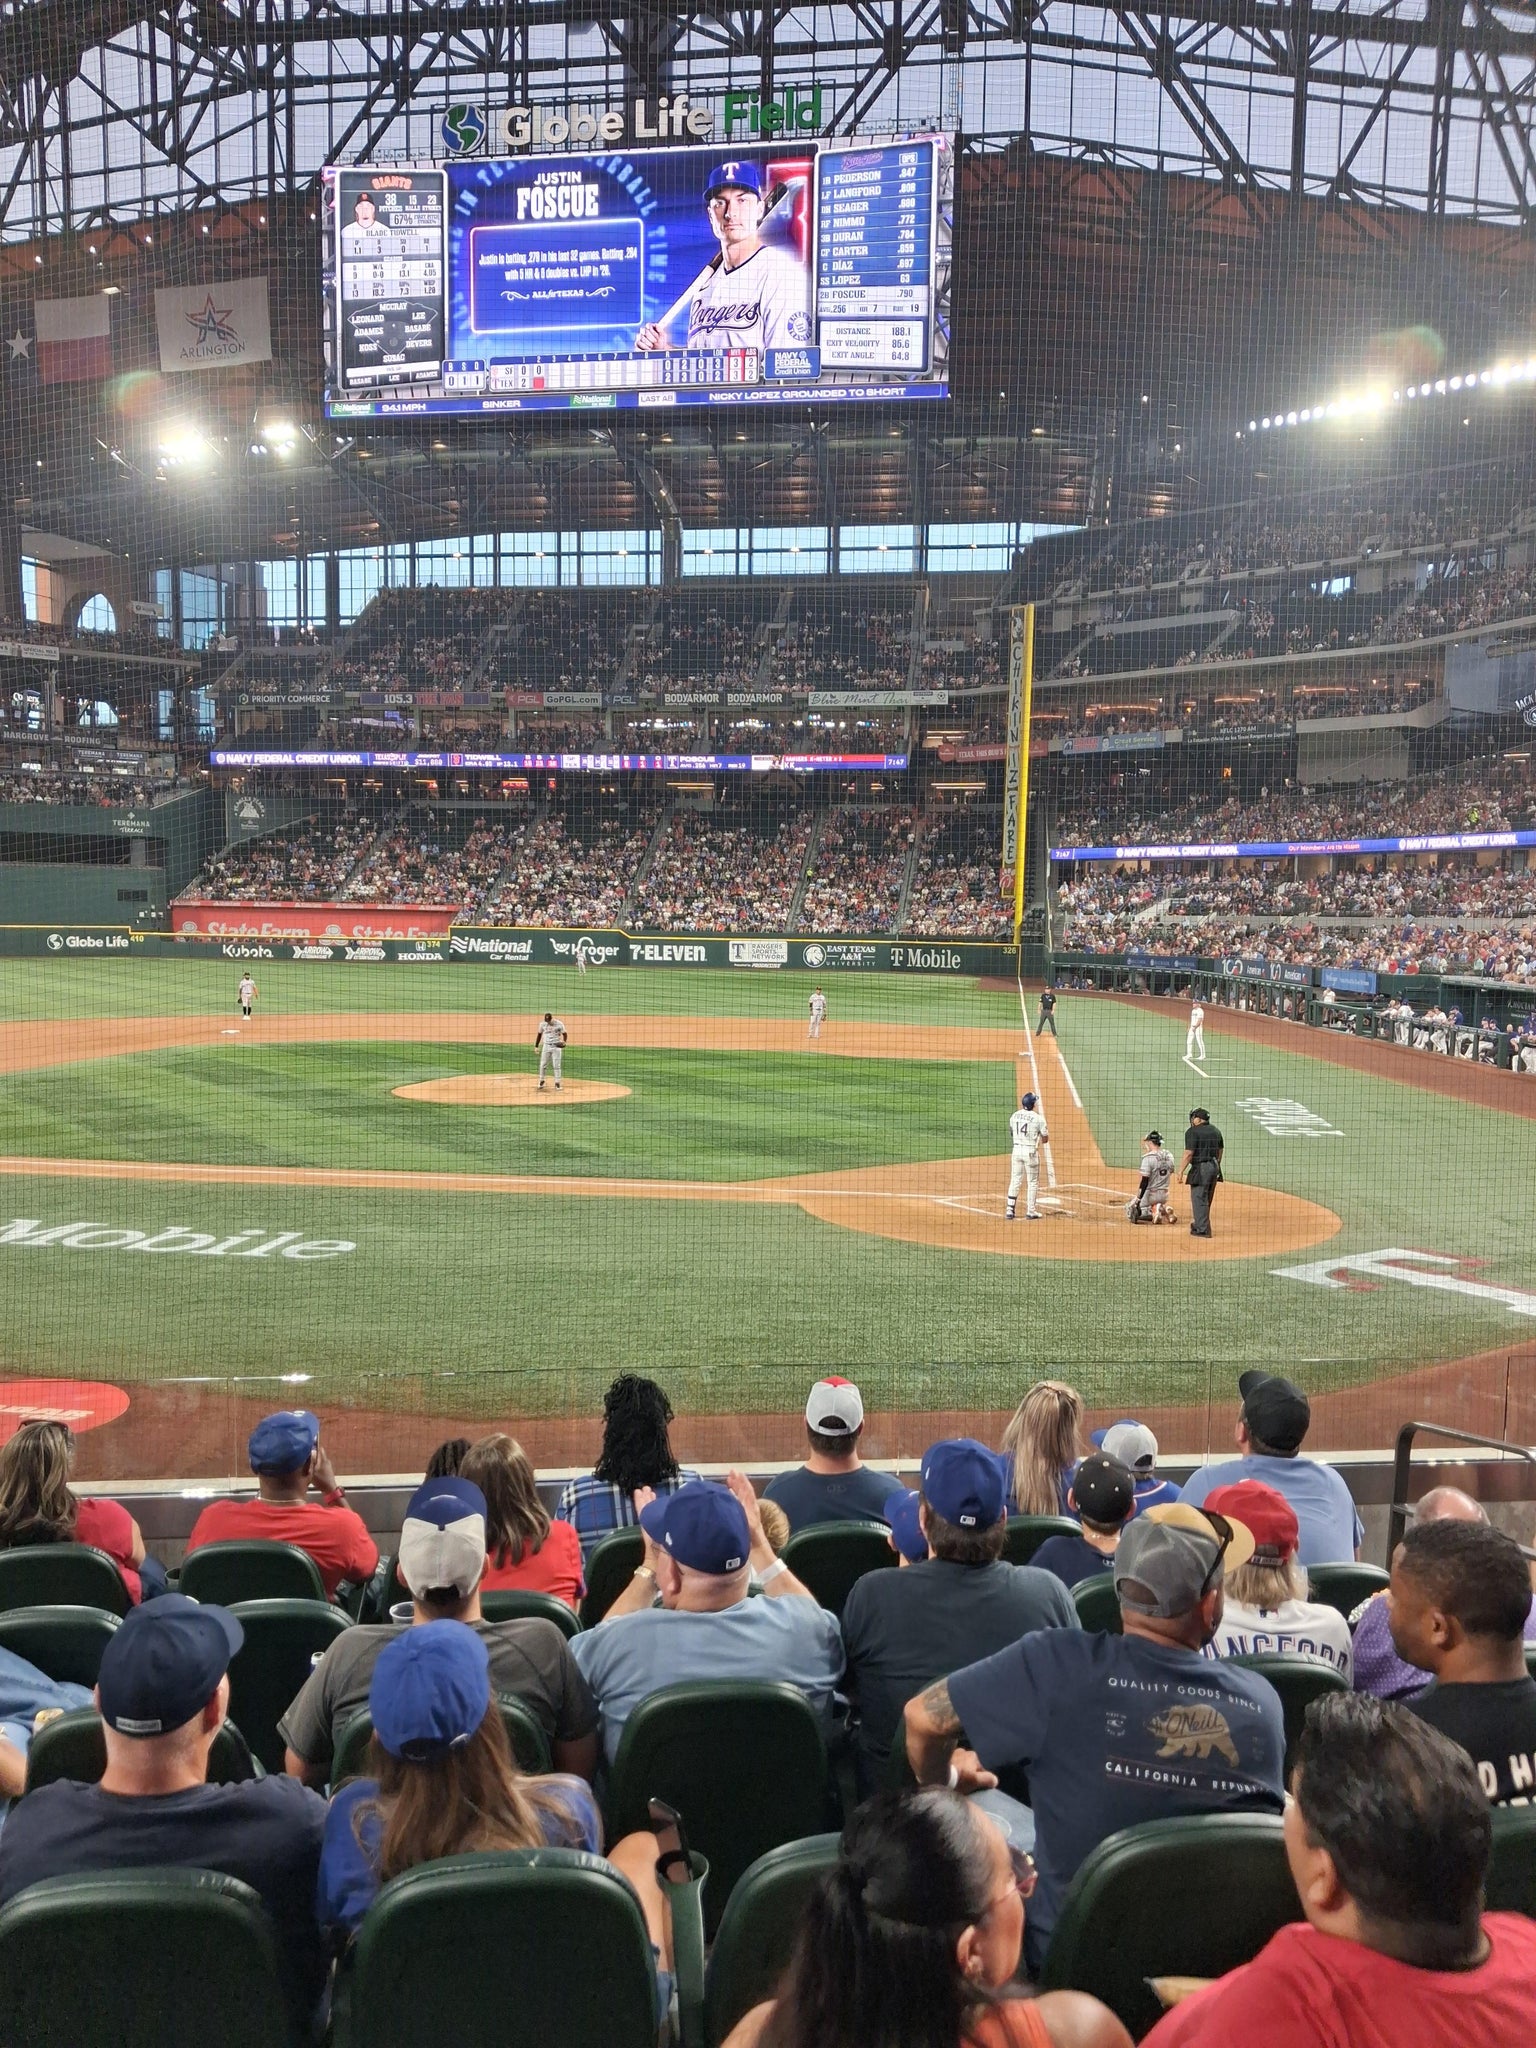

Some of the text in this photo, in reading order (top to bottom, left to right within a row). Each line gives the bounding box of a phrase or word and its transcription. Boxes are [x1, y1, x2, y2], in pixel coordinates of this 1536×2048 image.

[499, 86, 822, 146] Globe Life Field
[534, 171, 582, 185] JUSTIN
[834, 170, 882, 184] PEDERSON
[372, 176, 412, 190] GIANTS
[822, 186, 882, 200] LF LANGFORD
[385, 194, 417, 206] 38 15
[517, 184, 599, 220] FOSCUE
[834, 202, 869, 213] SEAGER
[394, 214, 413, 225] 67%
[833, 214, 915, 228] NIMMO .772
[833, 230, 914, 241] DURAN .784
[820, 246, 868, 256] CF CARTER
[479, 248, 624, 266] Justin batting in his last games. Batting
[832, 260, 854, 270] DÍAZ
[504, 266, 598, 281] with HR doubles LHP in
[820, 275, 860, 285] SS LOPEZ
[832, 290, 866, 298] FOSCUE
[897, 289, 913, 298] .790
[379, 302, 408, 311] MCCRAY
[910, 304, 920, 312] 19
[352, 312, 426, 324] LEONARD LEE
[354, 328, 384, 336] ADAMES
[404, 324, 432, 333] BASABE
[892, 328, 911, 336] 188.1
[359, 344, 378, 352] KOSS
[406, 340, 432, 348] DEVERS
[892, 340, 910, 348] 85.6
[180, 341, 246, 358] ARLINGTON
[774, 352, 798, 360] NAVY
[892, 352, 910, 360] 64.8
[774, 358, 810, 366] FEDERAL
[582, 395, 612, 404] National
[710, 388, 906, 401] NICKY LOPEZ GROUNDED TO SHORT
[482, 400, 521, 408] SINKER
[252, 694, 330, 702] PRIORITY COMMERCE
[384, 694, 412, 704] 105.3
[414, 694, 438, 704] THE
[664, 694, 720, 704] BODYARMOR
[728, 694, 783, 704] BODYARMOR
[811, 692, 878, 704] Blue Mint
[1009, 644, 1022, 744] CHIKIN
[518, 696, 540, 704] PGL
[546, 696, 598, 704] GoPGL.com
[613, 696, 636, 704] PGL
[1514, 694, 1534, 712] JACK
[4, 731, 49, 741] HARGROVE
[64, 736, 100, 745] ROOFING
[226, 754, 252, 763] NAVY
[254, 754, 294, 763] FEDERAL
[296, 754, 328, 763] CREDIT
[330, 754, 362, 763] UNION.
[976, 750, 988, 758] THIS
[1006, 793, 1016, 860] FARE
[1406, 838, 1427, 849] NAVY
[1428, 836, 1460, 848] FEDERAL
[1461, 836, 1488, 847] CREDIT
[1124, 848, 1145, 857] NAVY
[1147, 848, 1180, 856] FEDERAL
[1182, 847, 1210, 856] CREDIT
[66, 936, 129, 948] Globe Life
[468, 938, 533, 953] National
[222, 944, 274, 958] Kubota
[304, 946, 328, 955] ARROW
[356, 947, 380, 956] ARROW
[571, 937, 620, 964] Kroger
[630, 944, 706, 962] 7-ELEVEN
[1002, 946, 1017, 954] 326
[398, 952, 443, 960] HONDA
[840, 952, 862, 961] A&M
[907, 948, 960, 969] Mobile
[1246, 967, 1262, 977] American
[1284, 969, 1303, 981] American
[1016, 1122, 1028, 1137] 14
[0, 1218, 357, 1259] Mobile
[1108, 1678, 1263, 1714] QUALITY GOODS SINCE
[1105, 1761, 1198, 1787] CALIFORNIA
